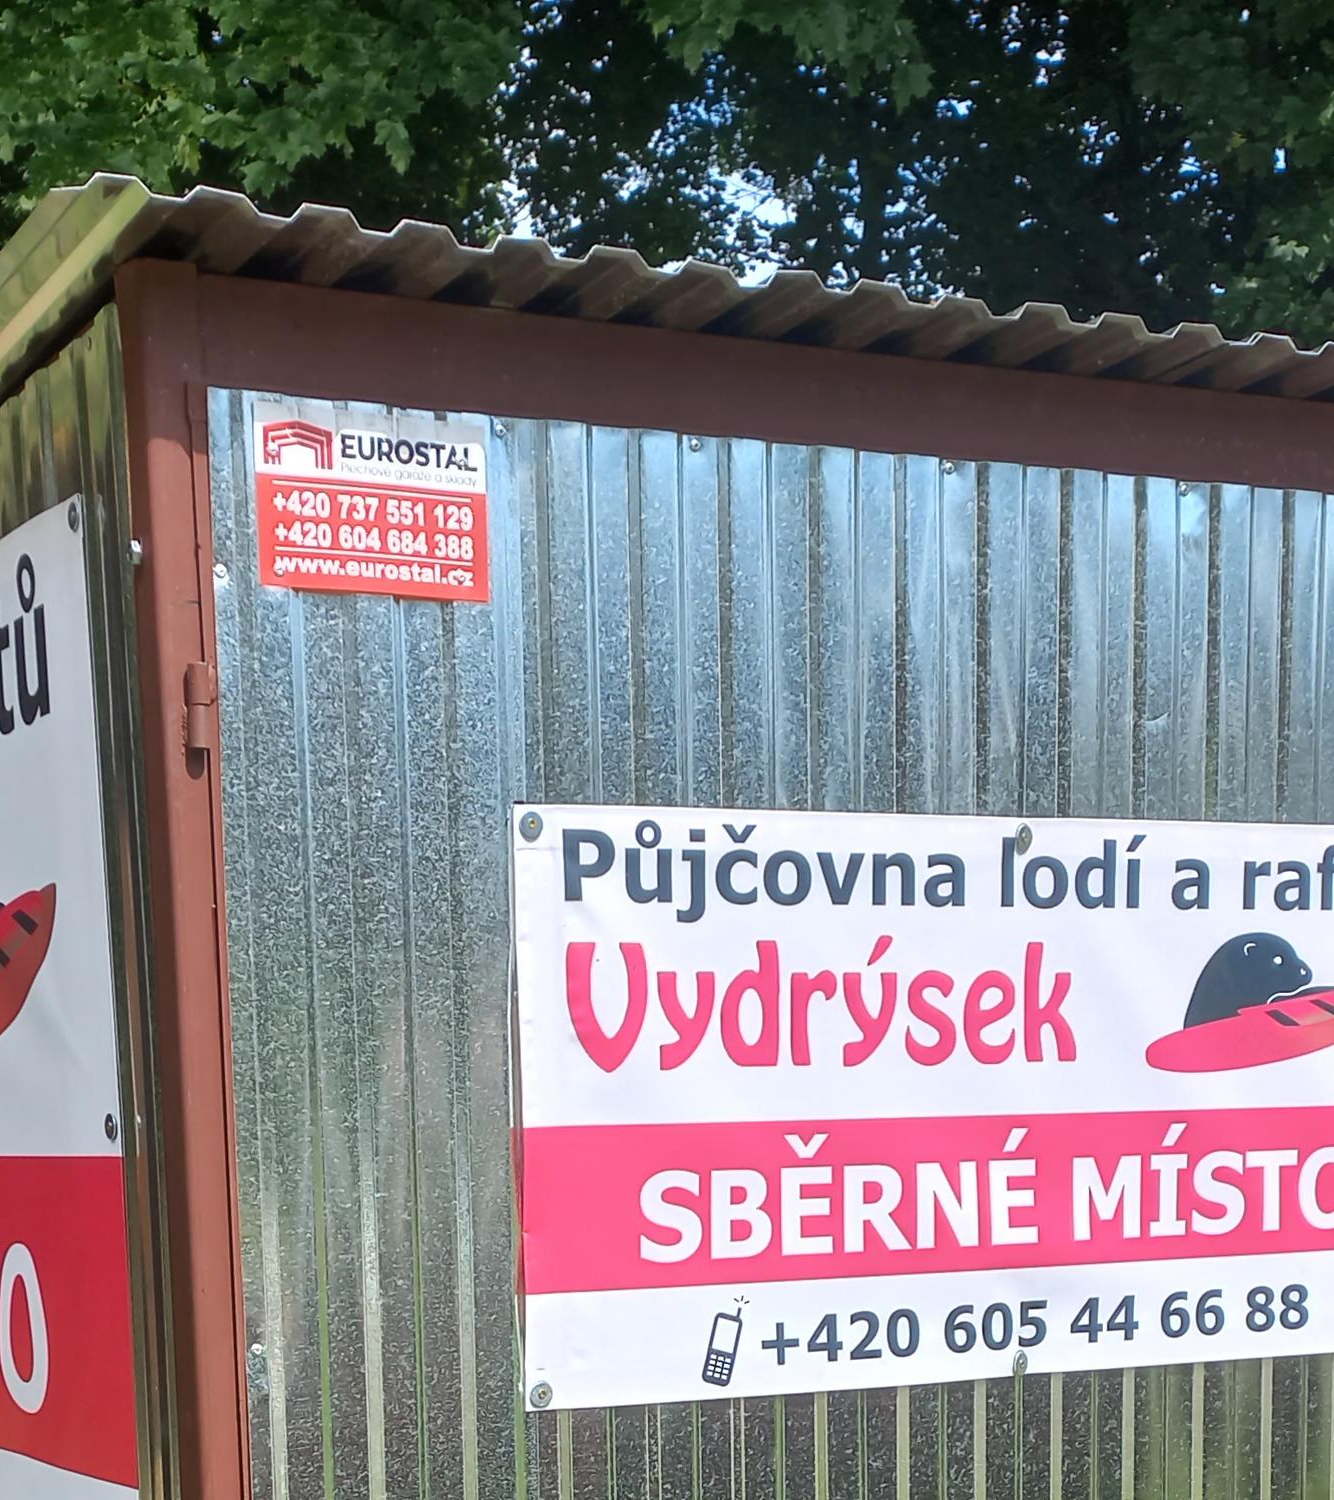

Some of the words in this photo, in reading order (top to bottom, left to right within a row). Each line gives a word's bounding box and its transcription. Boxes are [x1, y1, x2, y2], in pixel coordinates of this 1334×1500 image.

[341, 433, 477, 472] EUROSTAL
[272, 490, 331, 519] +420
[337, 494, 380, 522] 737
[386, 498, 425, 527] 551
[433, 503, 474, 532] 129
[274, 522, 333, 548] +420
[338, 526, 381, 552] 604
[387, 530, 428, 557] 684
[434, 534, 474, 561] 388
[273, 556, 475, 588] www.eurostal.cz
[562, 820, 967, 923] Půjčovna
[1000, 835, 1143, 911] lodí
[1171, 858, 1211, 910] a
[565, 935, 1078, 1074] Vydrýsek
[638, 1128, 1040, 1264] SBĚRNÉ
[760, 1309, 921, 1365] +420
[944, 1301, 1049, 1352] 605
[1071, 1294, 1140, 1344] 44
[1159, 1288, 1225, 1338] 66
[1245, 1283, 1310, 1333] 88
